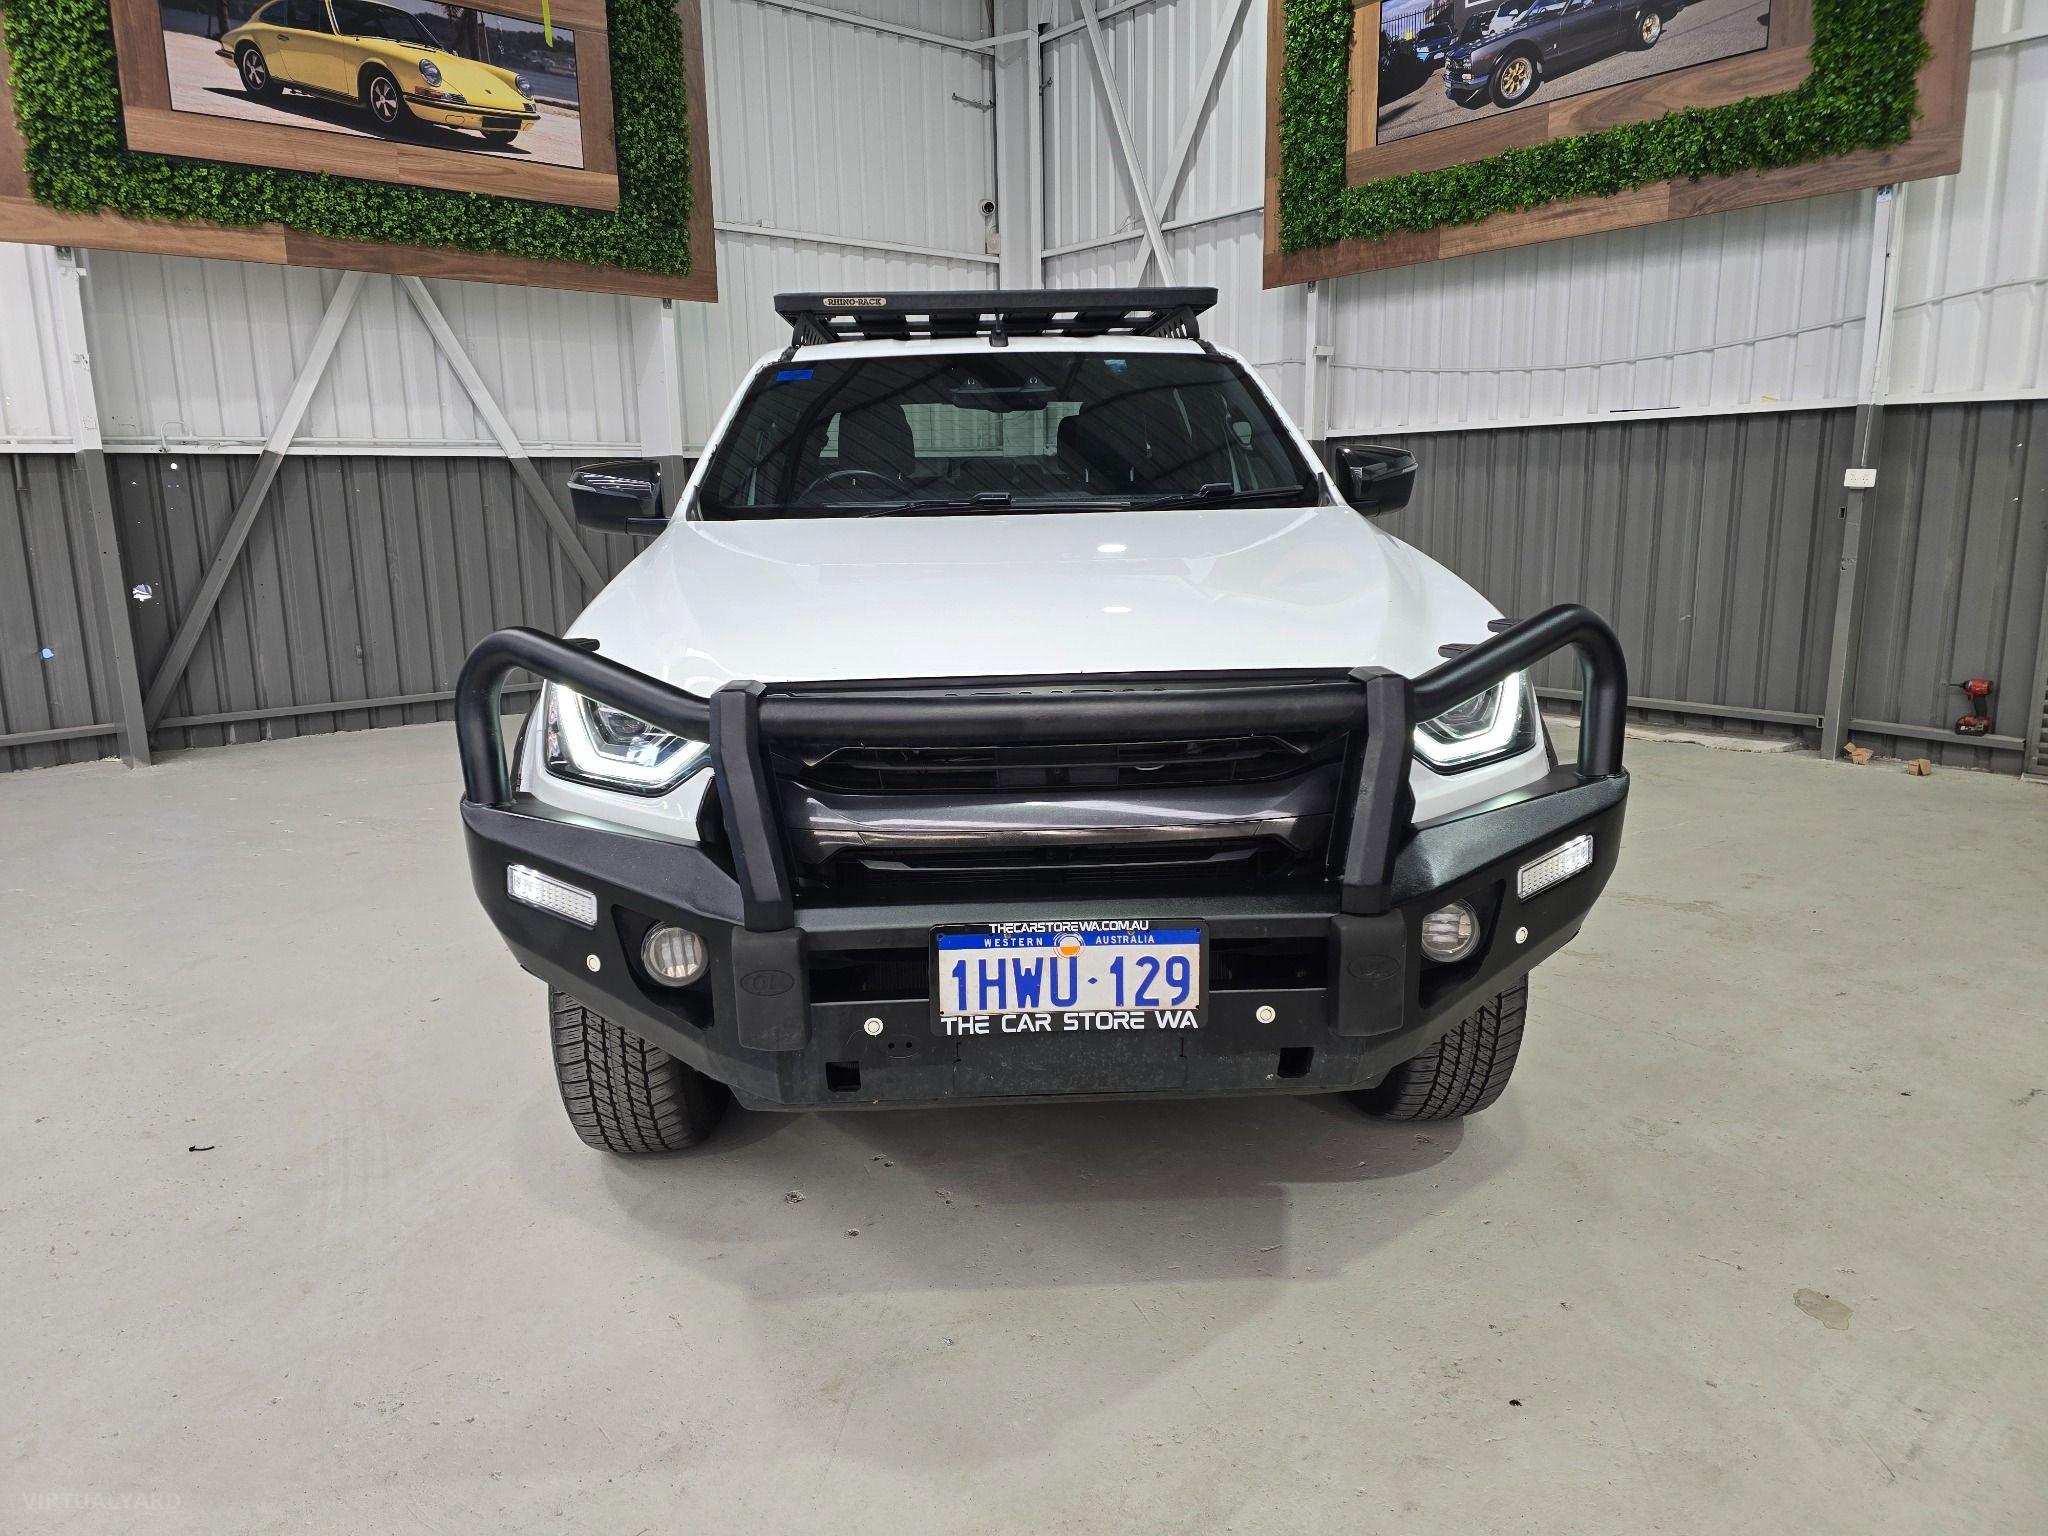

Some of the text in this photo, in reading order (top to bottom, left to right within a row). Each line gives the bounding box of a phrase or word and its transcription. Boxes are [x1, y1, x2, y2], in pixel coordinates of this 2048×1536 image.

[988, 920, 1149, 934] THECARSTOREWA.COM.AU
[984, 934, 1155, 947] WESTERN AUSTRALIA
[940, 1010, 1199, 1036] THE CAR STORE WA
